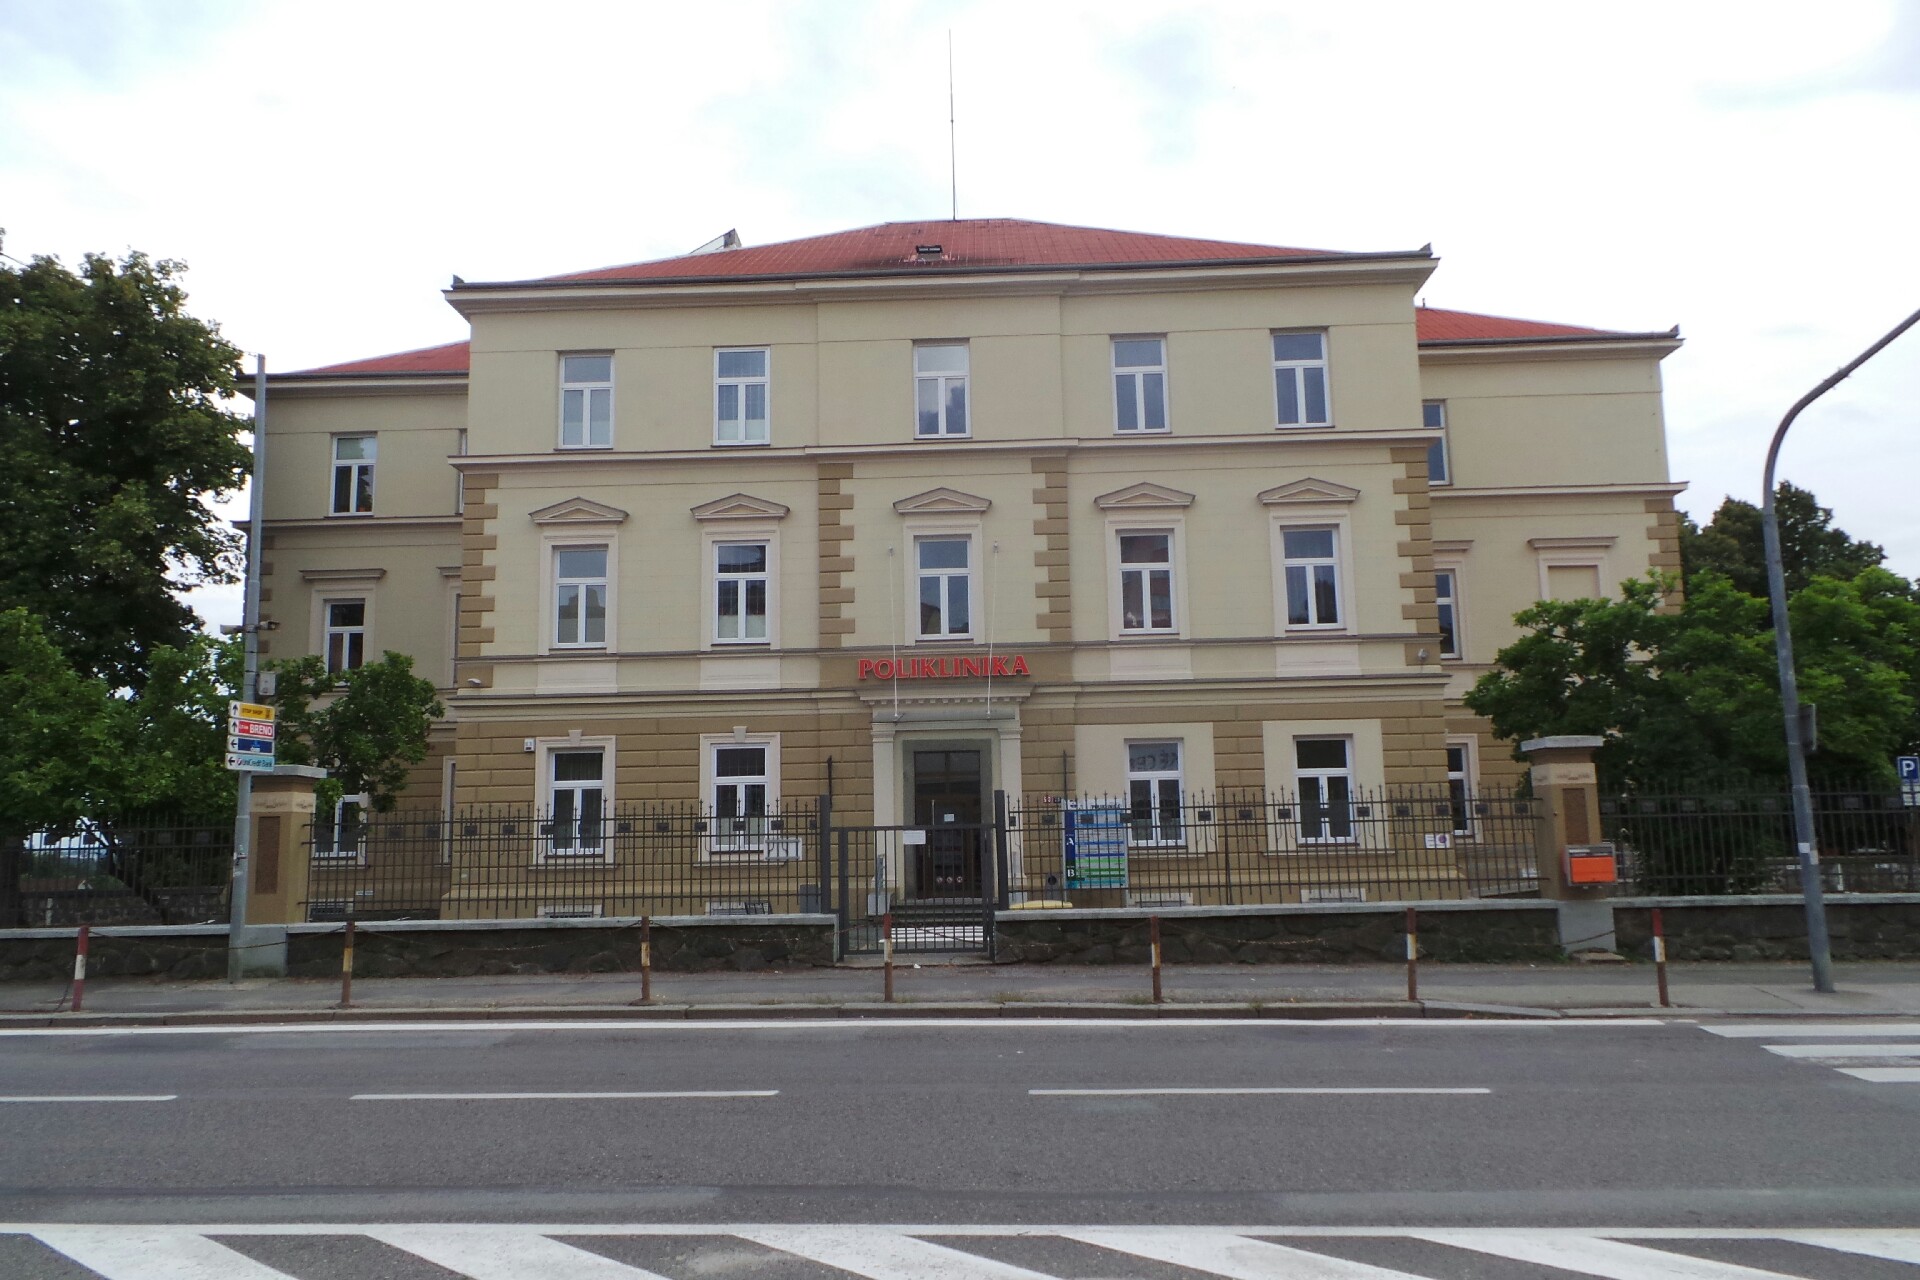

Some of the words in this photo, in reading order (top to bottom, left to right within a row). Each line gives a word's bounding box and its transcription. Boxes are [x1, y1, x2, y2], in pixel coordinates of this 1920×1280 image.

[858, 655, 1031, 680] POLIKLINIKA
[249, 723, 273, 736] BRENO
[1902, 760, 1915, 777] P
